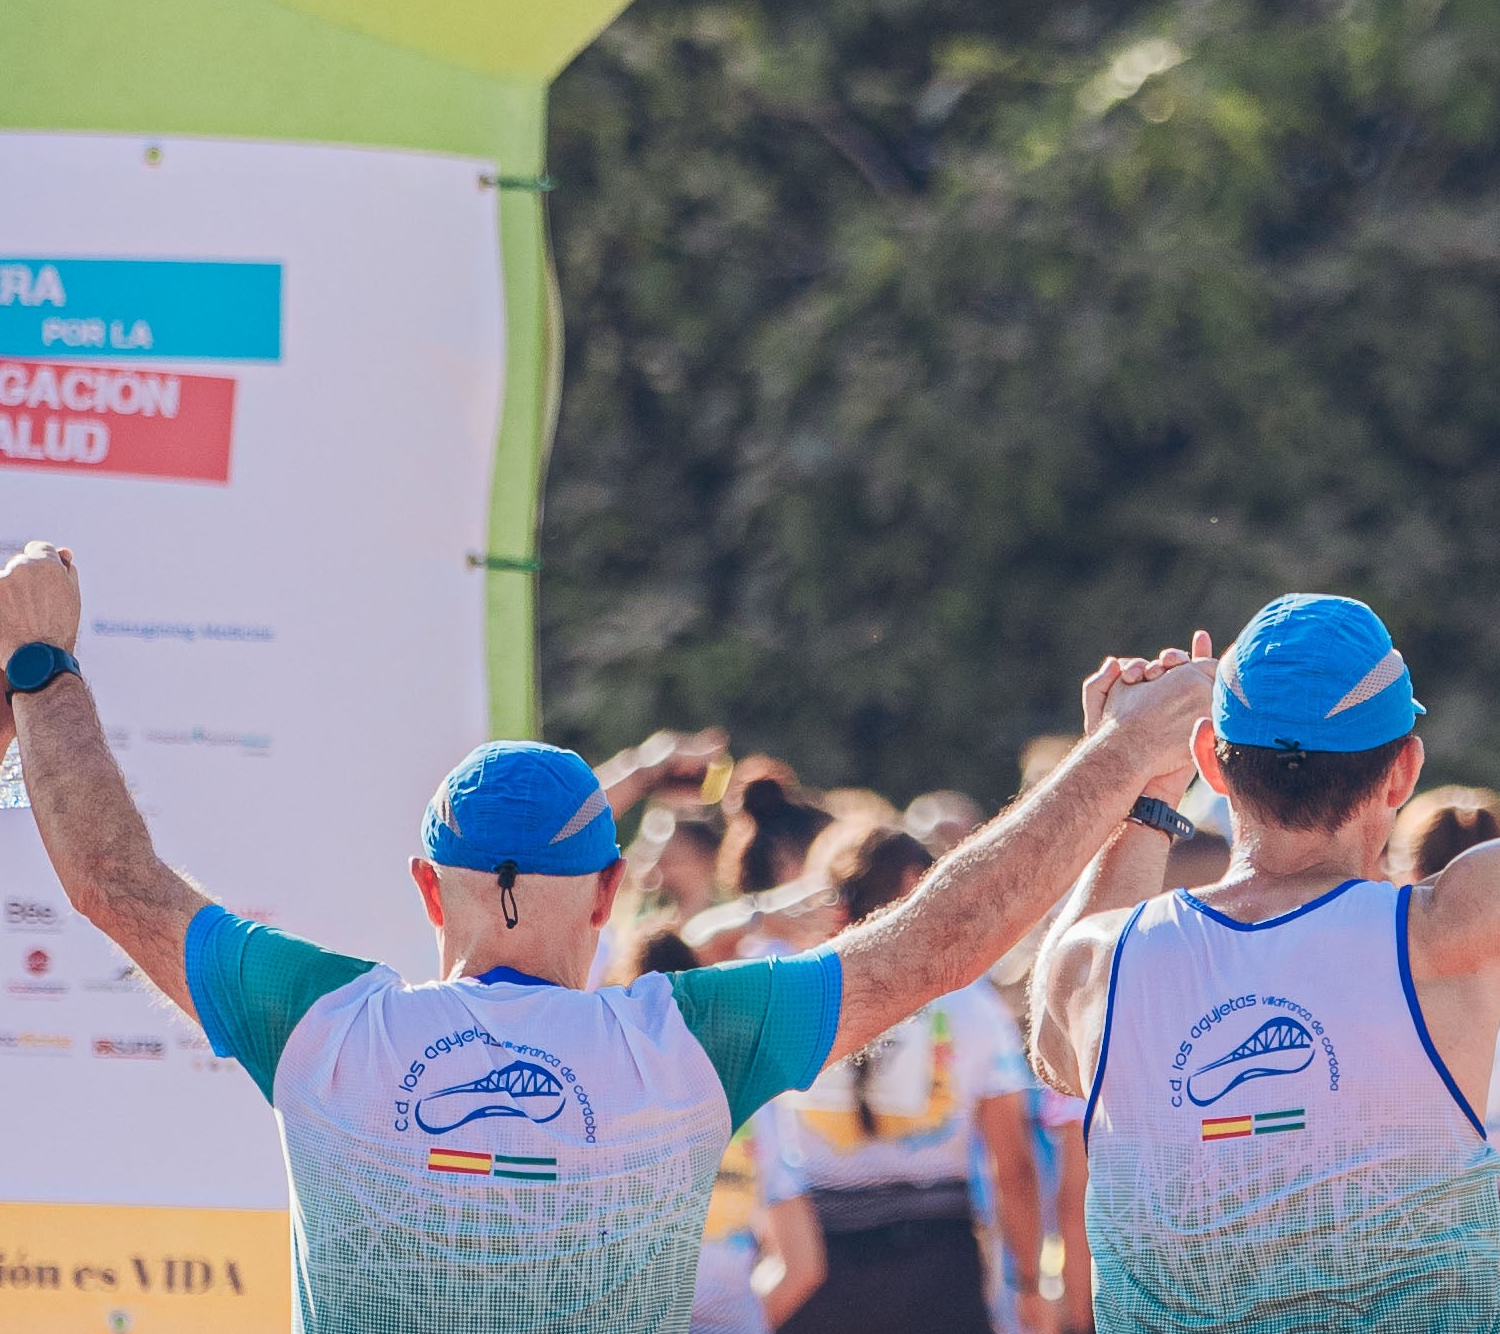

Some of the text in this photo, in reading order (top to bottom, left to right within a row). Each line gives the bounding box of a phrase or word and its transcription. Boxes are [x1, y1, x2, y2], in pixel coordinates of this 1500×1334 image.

[41, 317, 153, 350] POR LA
[1172, 1040, 1193, 1071] los
[1190, 994, 1257, 1039] agujetas
[1261, 996, 1313, 1022] villafranca
[1311, 1019, 1325, 1036] de
[398, 1059, 426, 1093] los
[560, 1066, 577, 1084] de
[130, 1254, 247, 1297] VIDA
